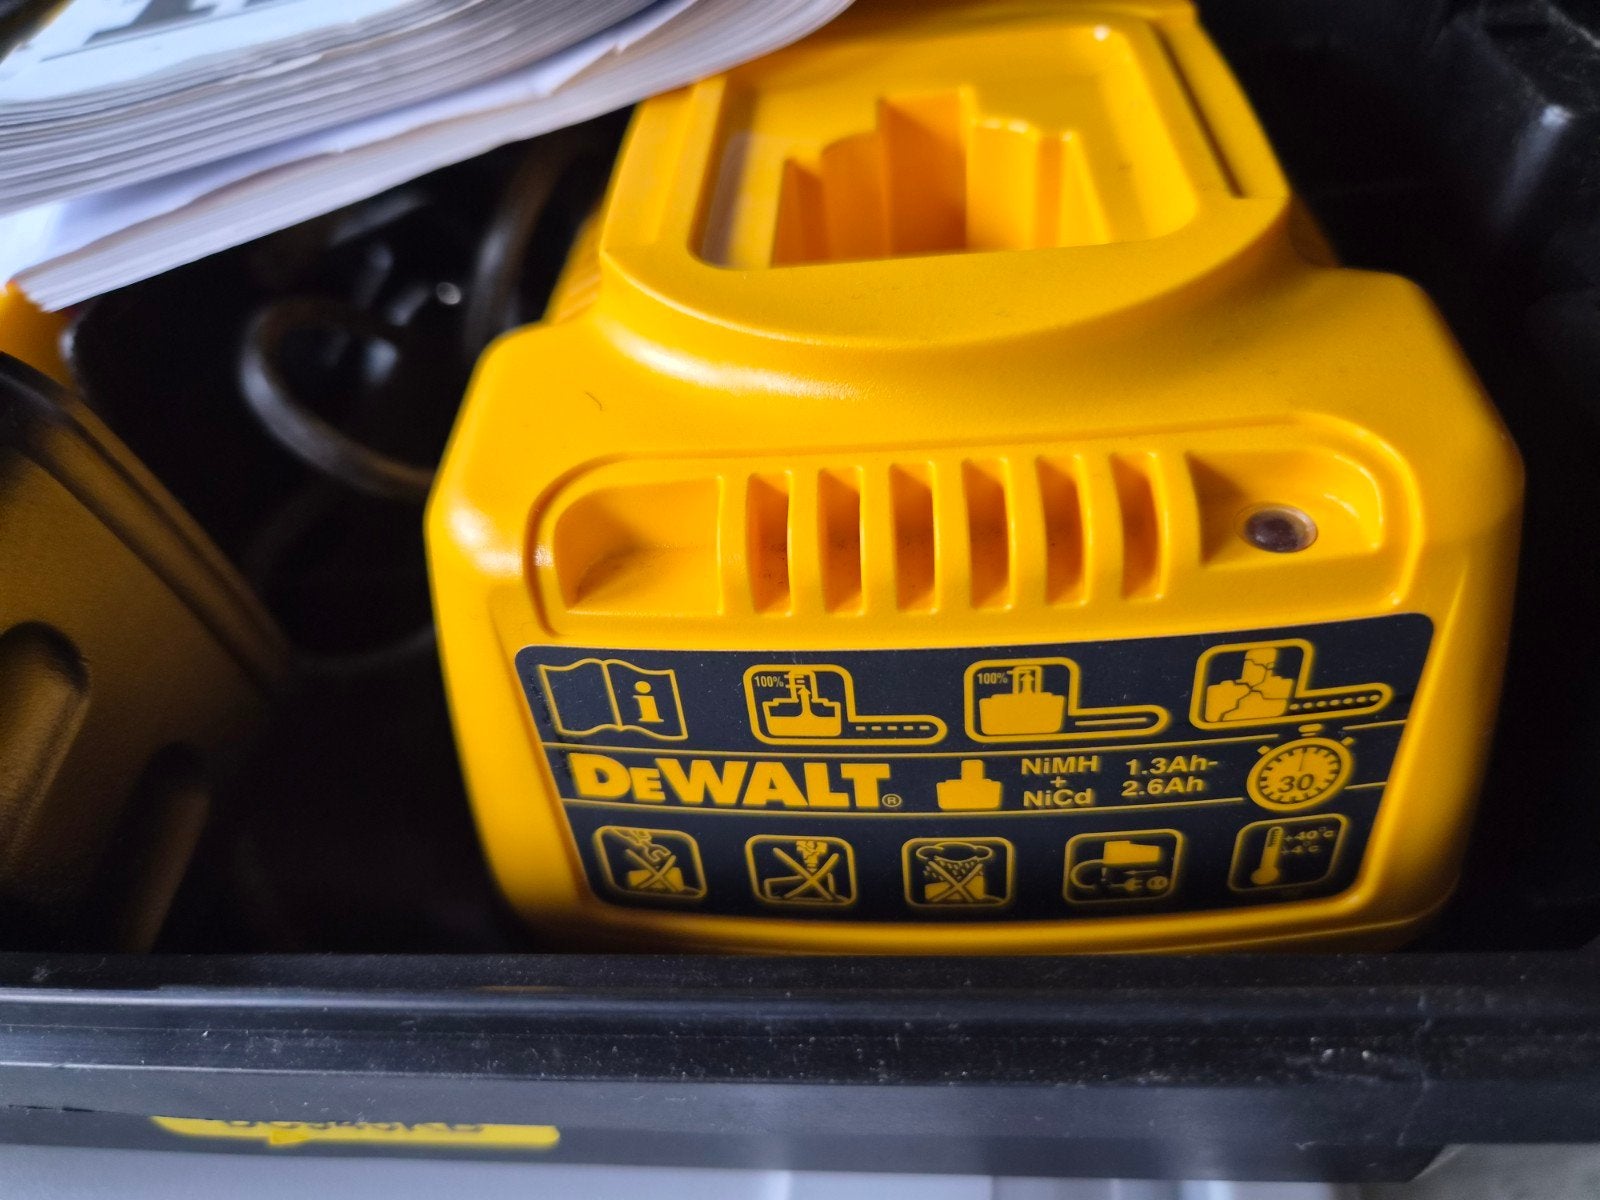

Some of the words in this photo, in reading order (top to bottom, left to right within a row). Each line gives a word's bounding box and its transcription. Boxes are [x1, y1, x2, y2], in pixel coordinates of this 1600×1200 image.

[754, 675, 785, 688] 100%
[977, 672, 1008, 685] 100%
[1021, 755, 1099, 775] NiMH
[1121, 776, 1206, 797] 2.6Ah
[1278, 773, 1315, 793] 30
[1023, 788, 1094, 808] NiCd
